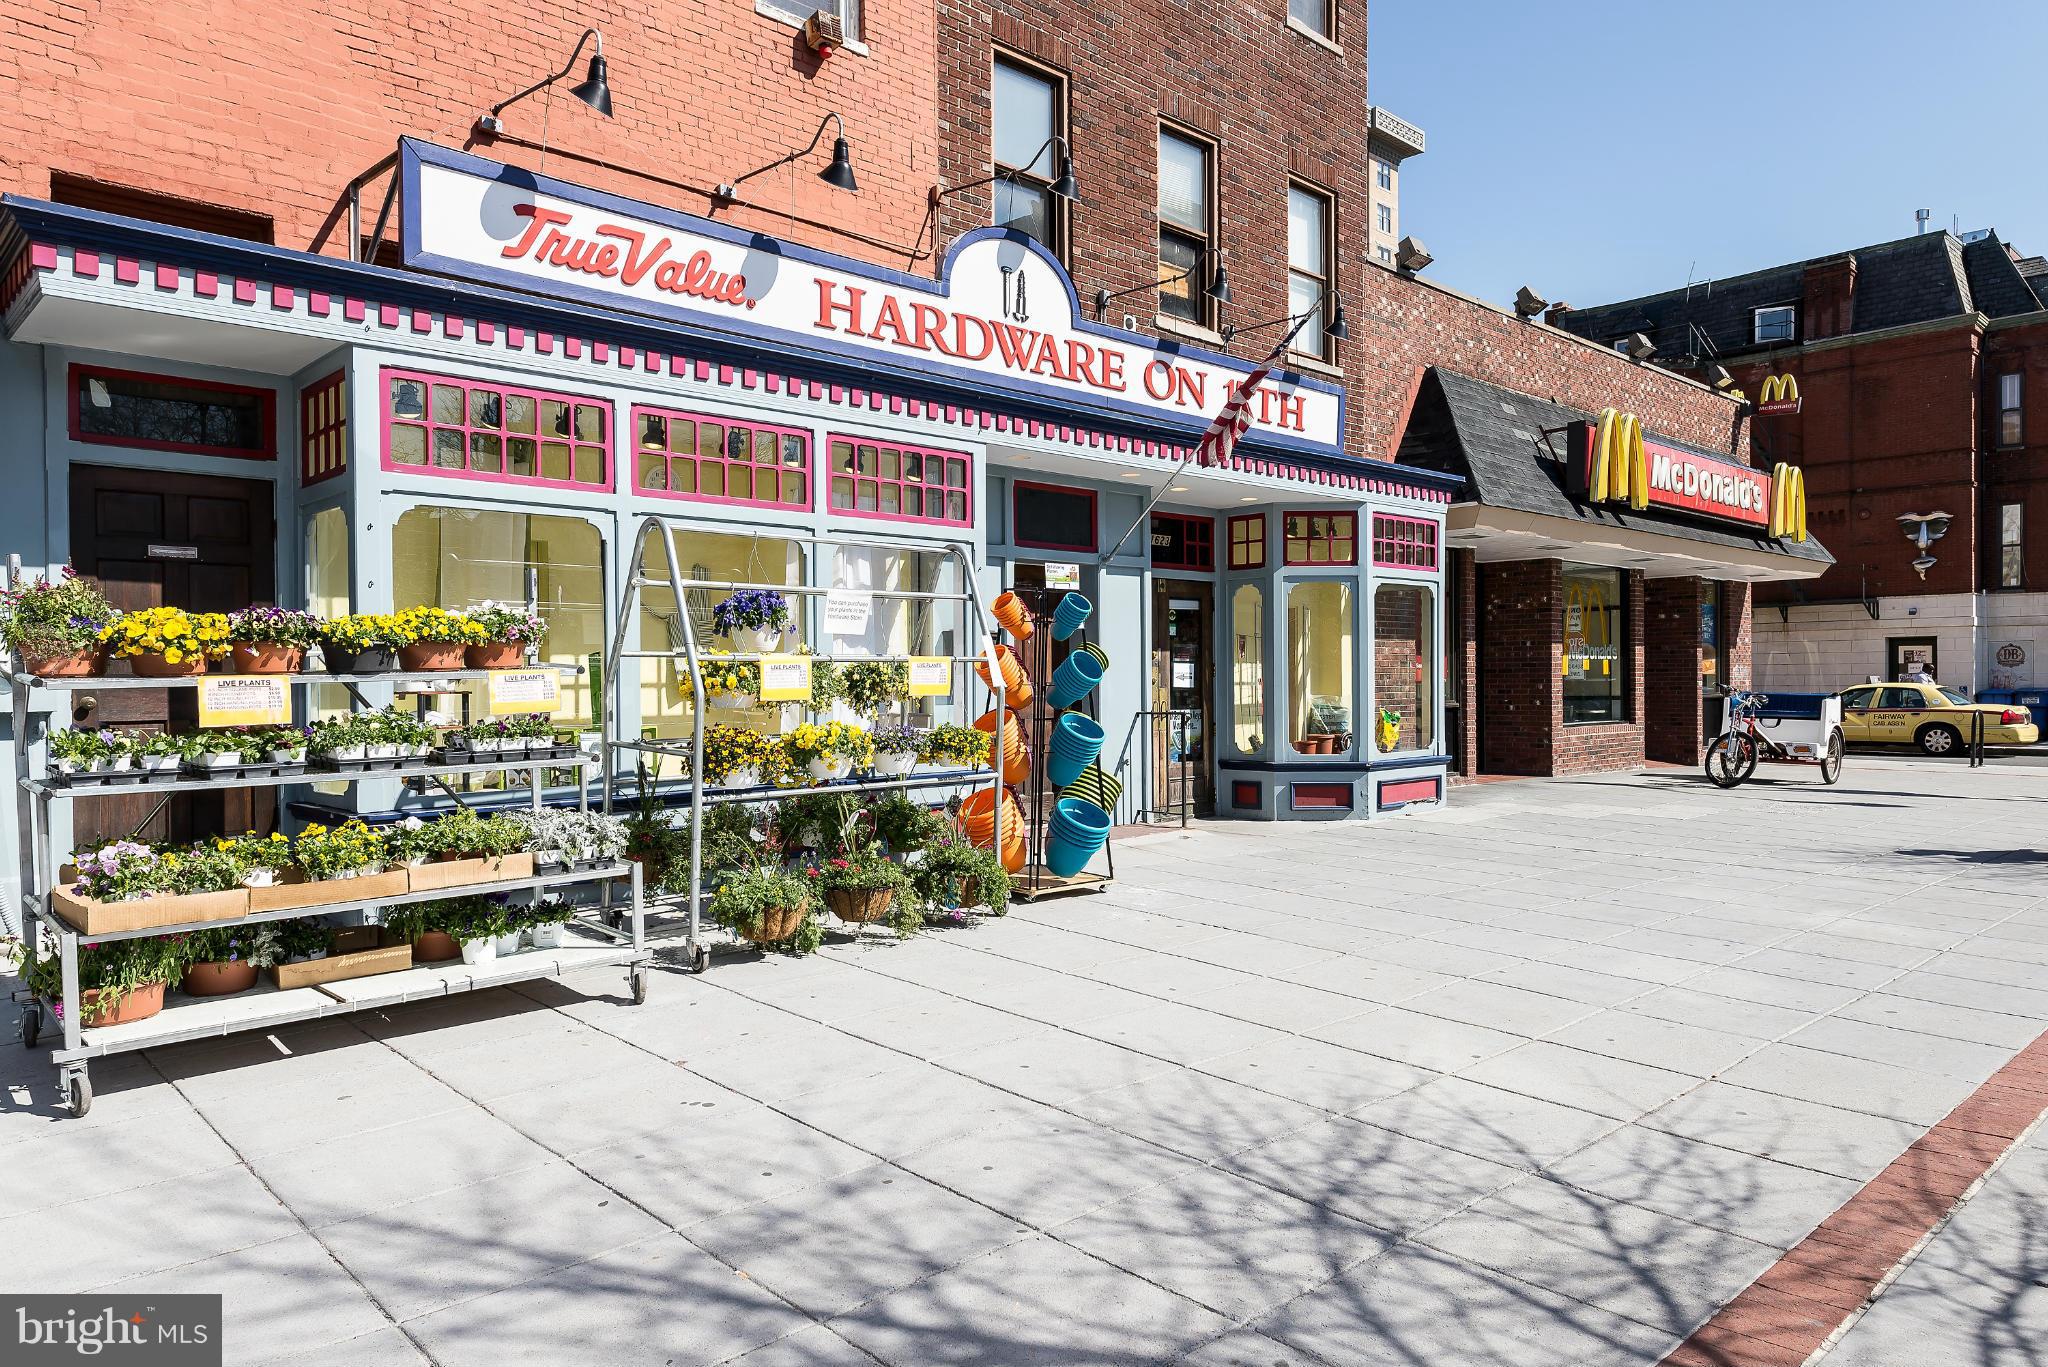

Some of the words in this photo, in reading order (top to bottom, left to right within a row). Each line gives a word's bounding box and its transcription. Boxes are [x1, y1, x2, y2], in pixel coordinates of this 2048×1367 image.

[813, 277, 1127, 392] HARDWARE
[1143, 359, 1208, 410] ON
[1223, 378, 1306, 432] 1TH
[1650, 453, 1763, 513] McDonald's
[2003, 648, 2019, 660] DB
